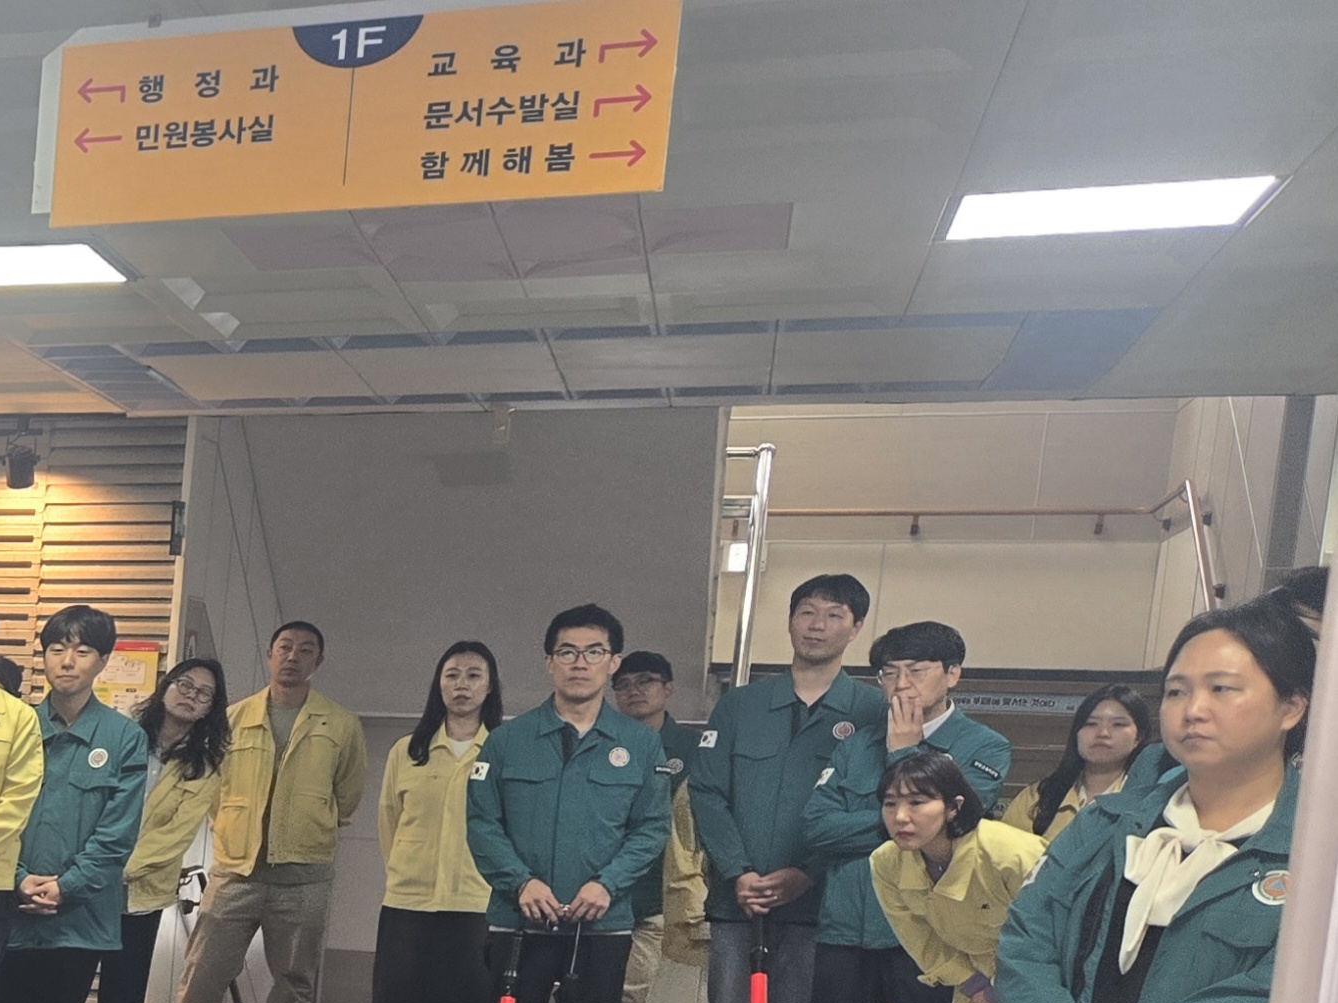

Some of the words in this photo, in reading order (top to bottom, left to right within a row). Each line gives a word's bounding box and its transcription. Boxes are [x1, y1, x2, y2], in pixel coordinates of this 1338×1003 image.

[331, 25, 387, 61] 1F
[423, 90, 581, 130] 문서수발실
[135, 114, 275, 152] 민원봉사실
